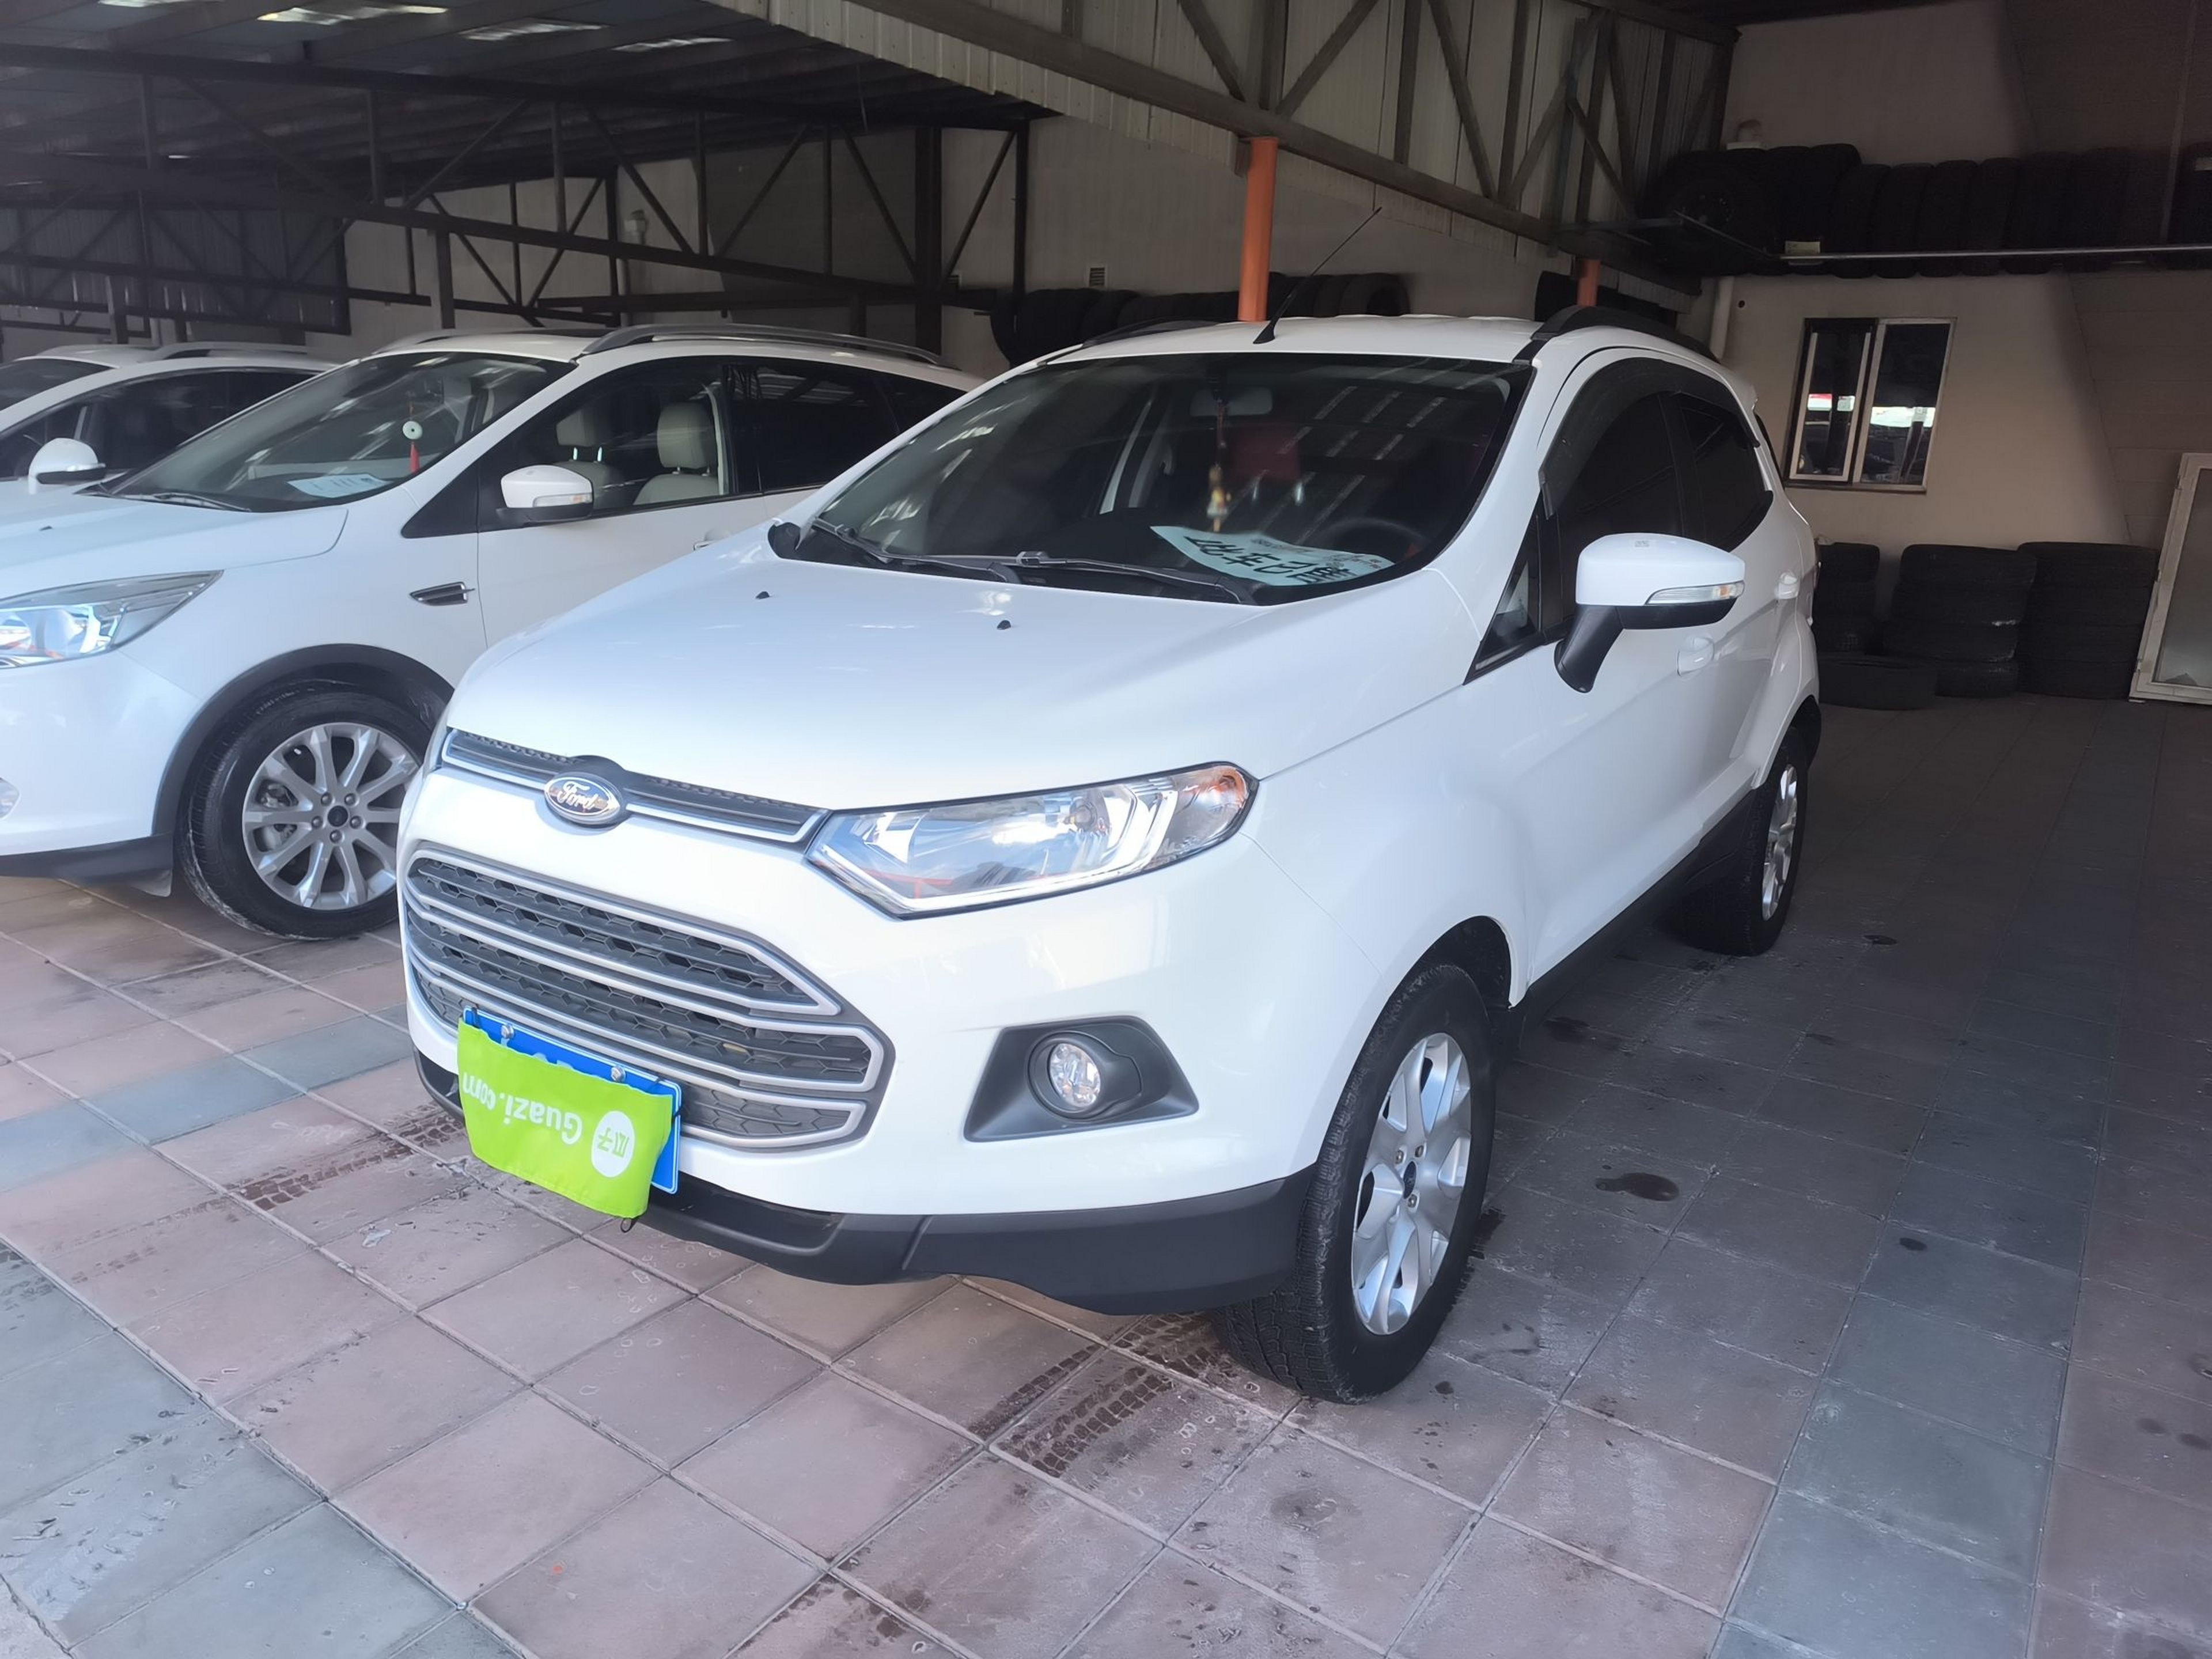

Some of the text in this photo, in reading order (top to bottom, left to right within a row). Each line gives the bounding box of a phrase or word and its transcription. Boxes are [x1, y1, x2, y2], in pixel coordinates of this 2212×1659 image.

[557, 782, 599, 809] Ford
[462, 1073, 582, 1145] Guazi.com
[597, 1127, 630, 1158] 瓜子
